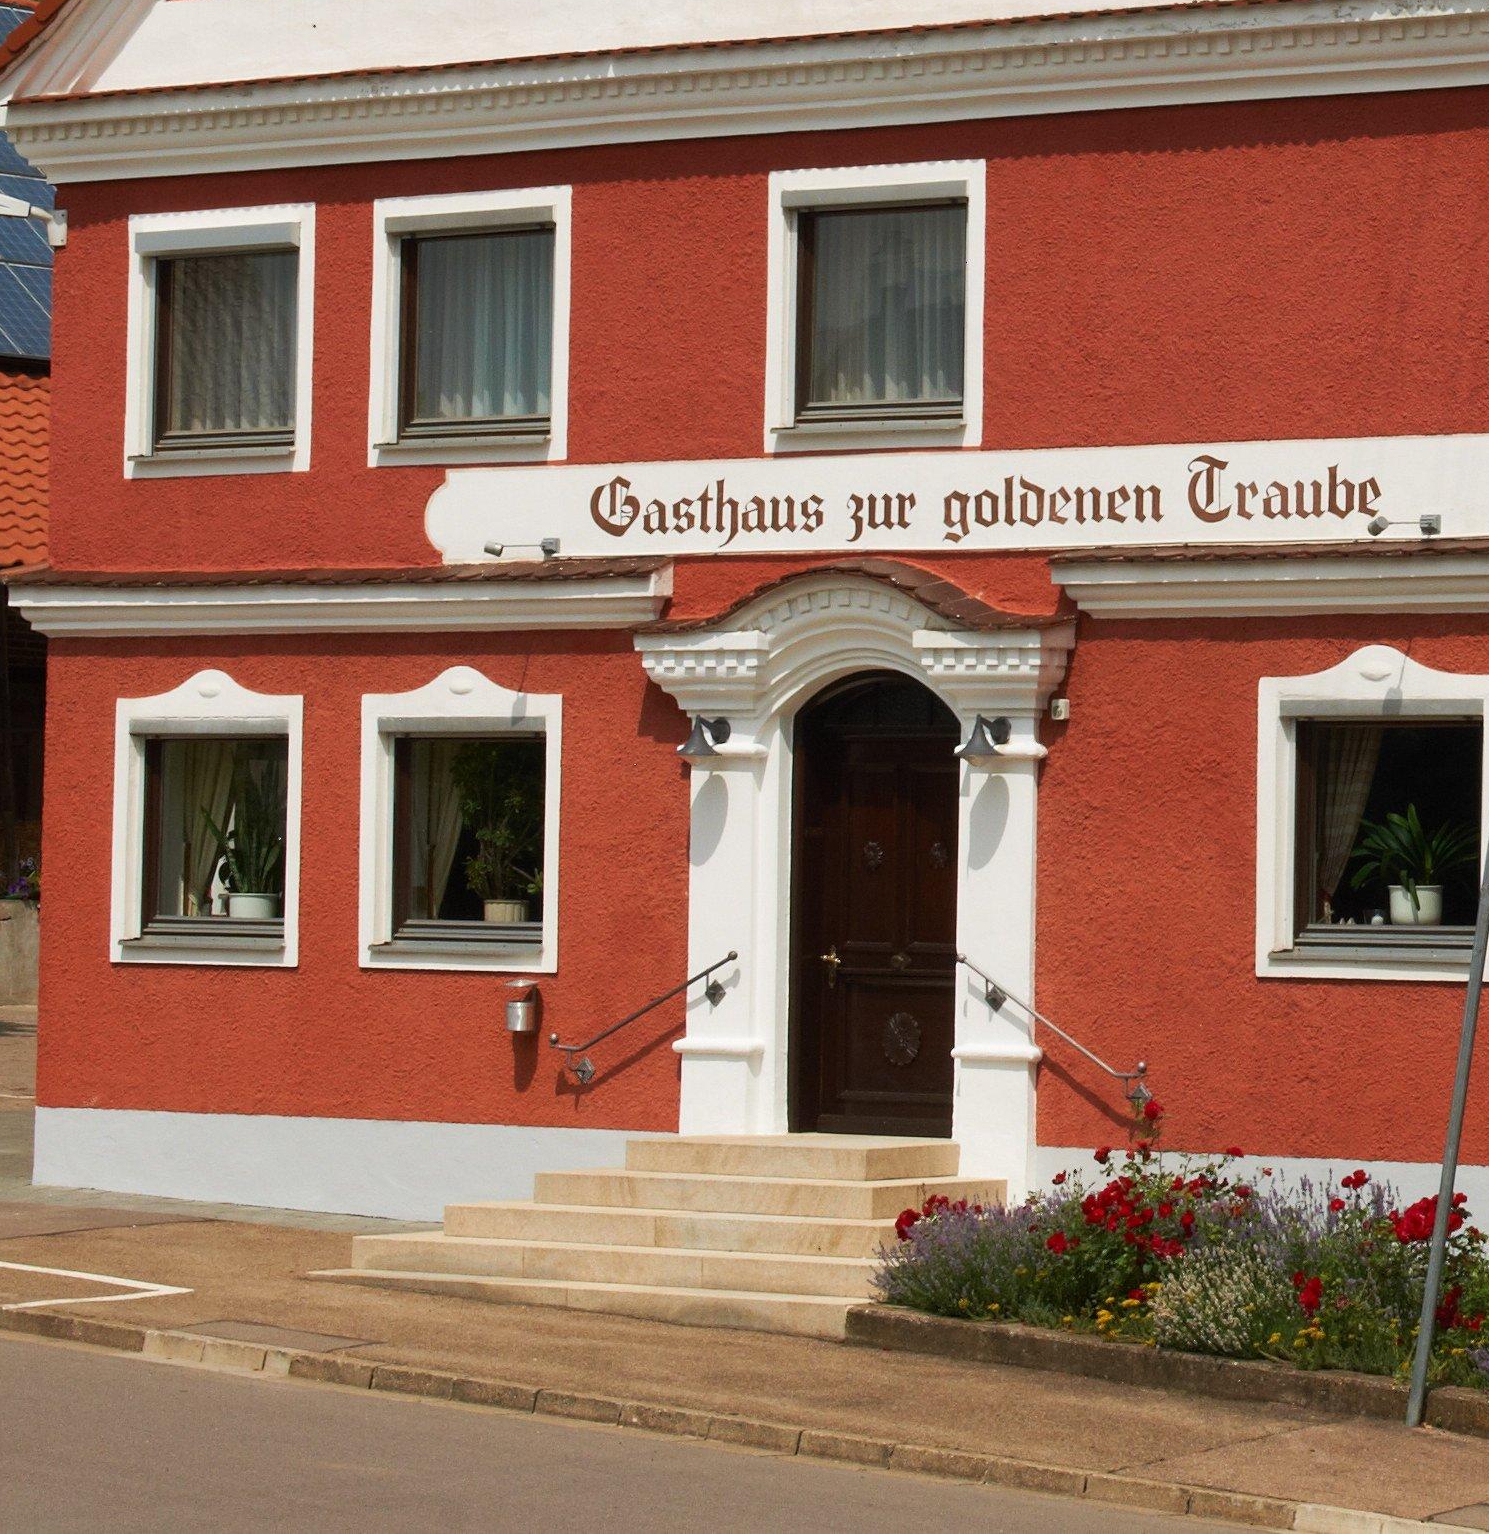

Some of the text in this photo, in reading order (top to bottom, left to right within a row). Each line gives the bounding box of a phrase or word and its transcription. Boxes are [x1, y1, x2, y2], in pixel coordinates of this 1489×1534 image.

[589, 453, 1383, 549] Gasthaus zur goldenen Traube
